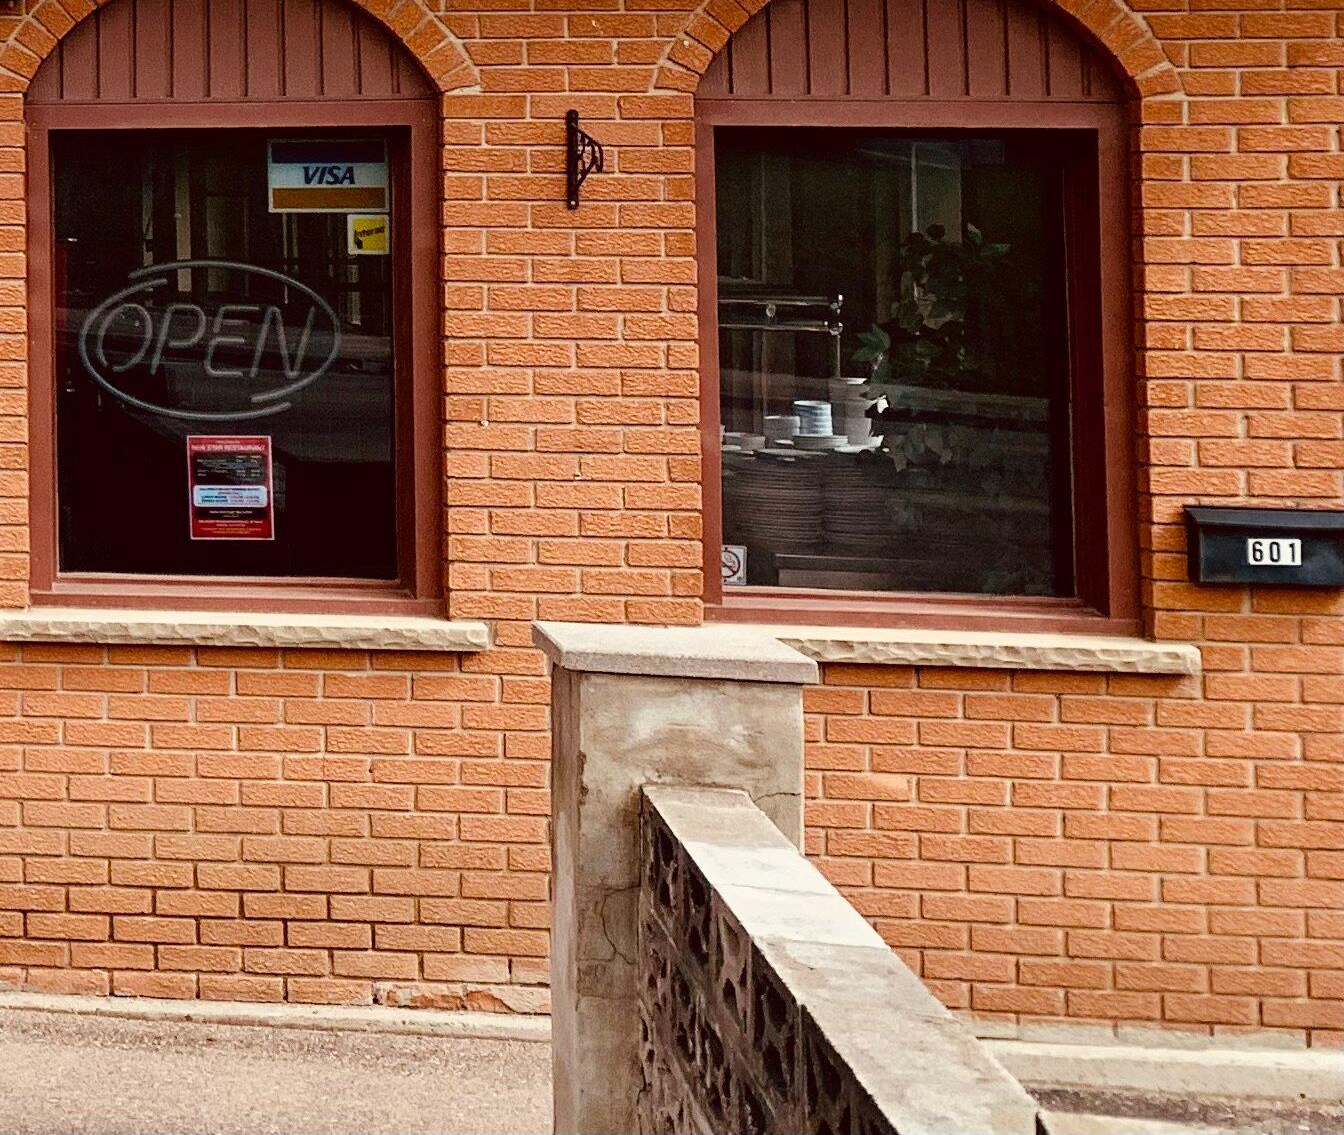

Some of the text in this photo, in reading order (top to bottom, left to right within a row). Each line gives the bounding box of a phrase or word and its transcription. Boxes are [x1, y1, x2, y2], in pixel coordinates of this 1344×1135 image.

[303, 165, 356, 185] VISA
[97, 303, 315, 379] OPEN
[1252, 541, 1296, 563] 601
